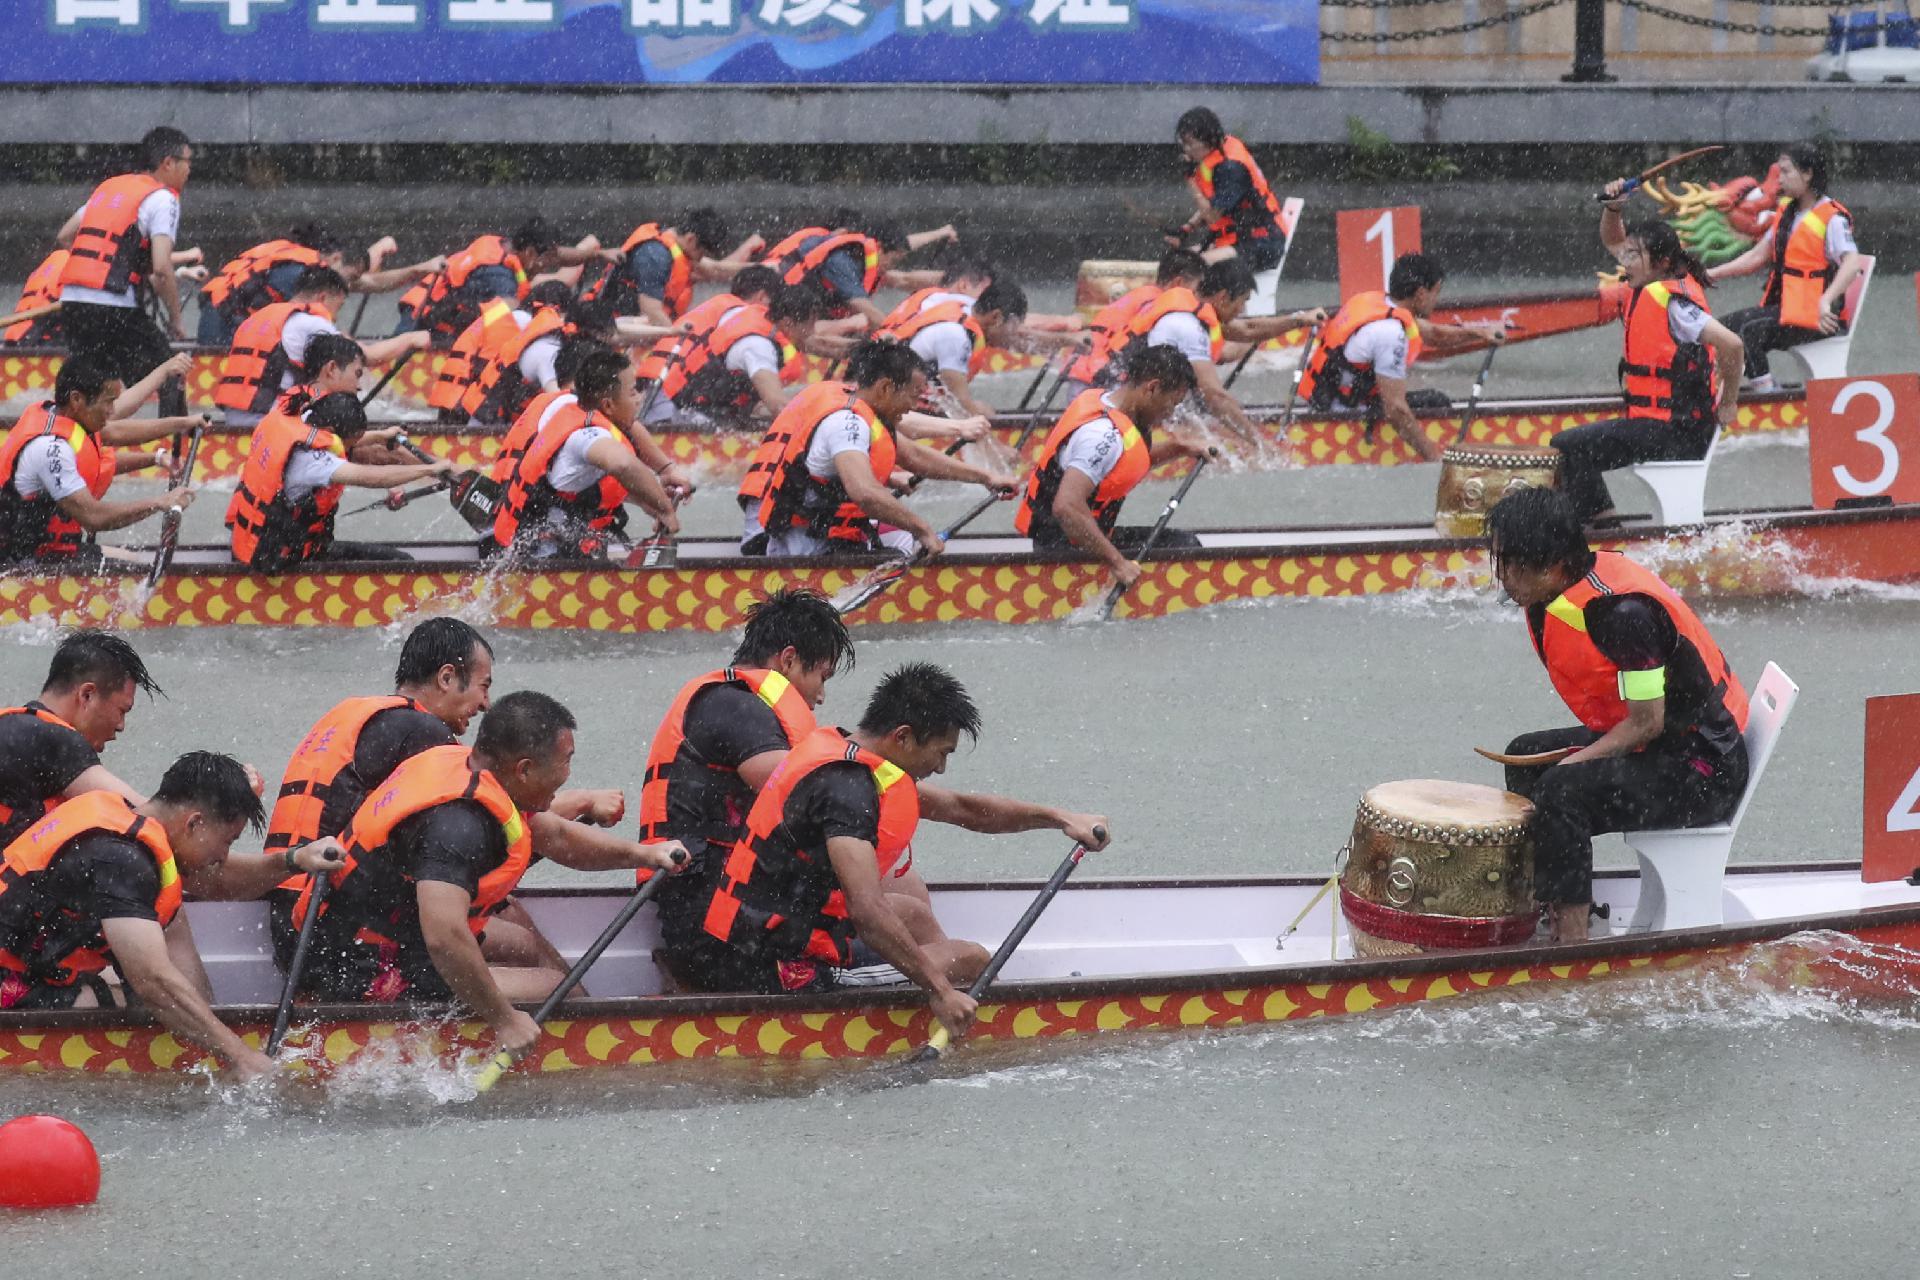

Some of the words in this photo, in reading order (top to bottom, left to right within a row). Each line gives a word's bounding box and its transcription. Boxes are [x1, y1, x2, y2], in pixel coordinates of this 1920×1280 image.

[1364, 210, 1395, 294] 1
[1831, 380, 1899, 496] 3
[469, 490, 493, 514] CHINA
